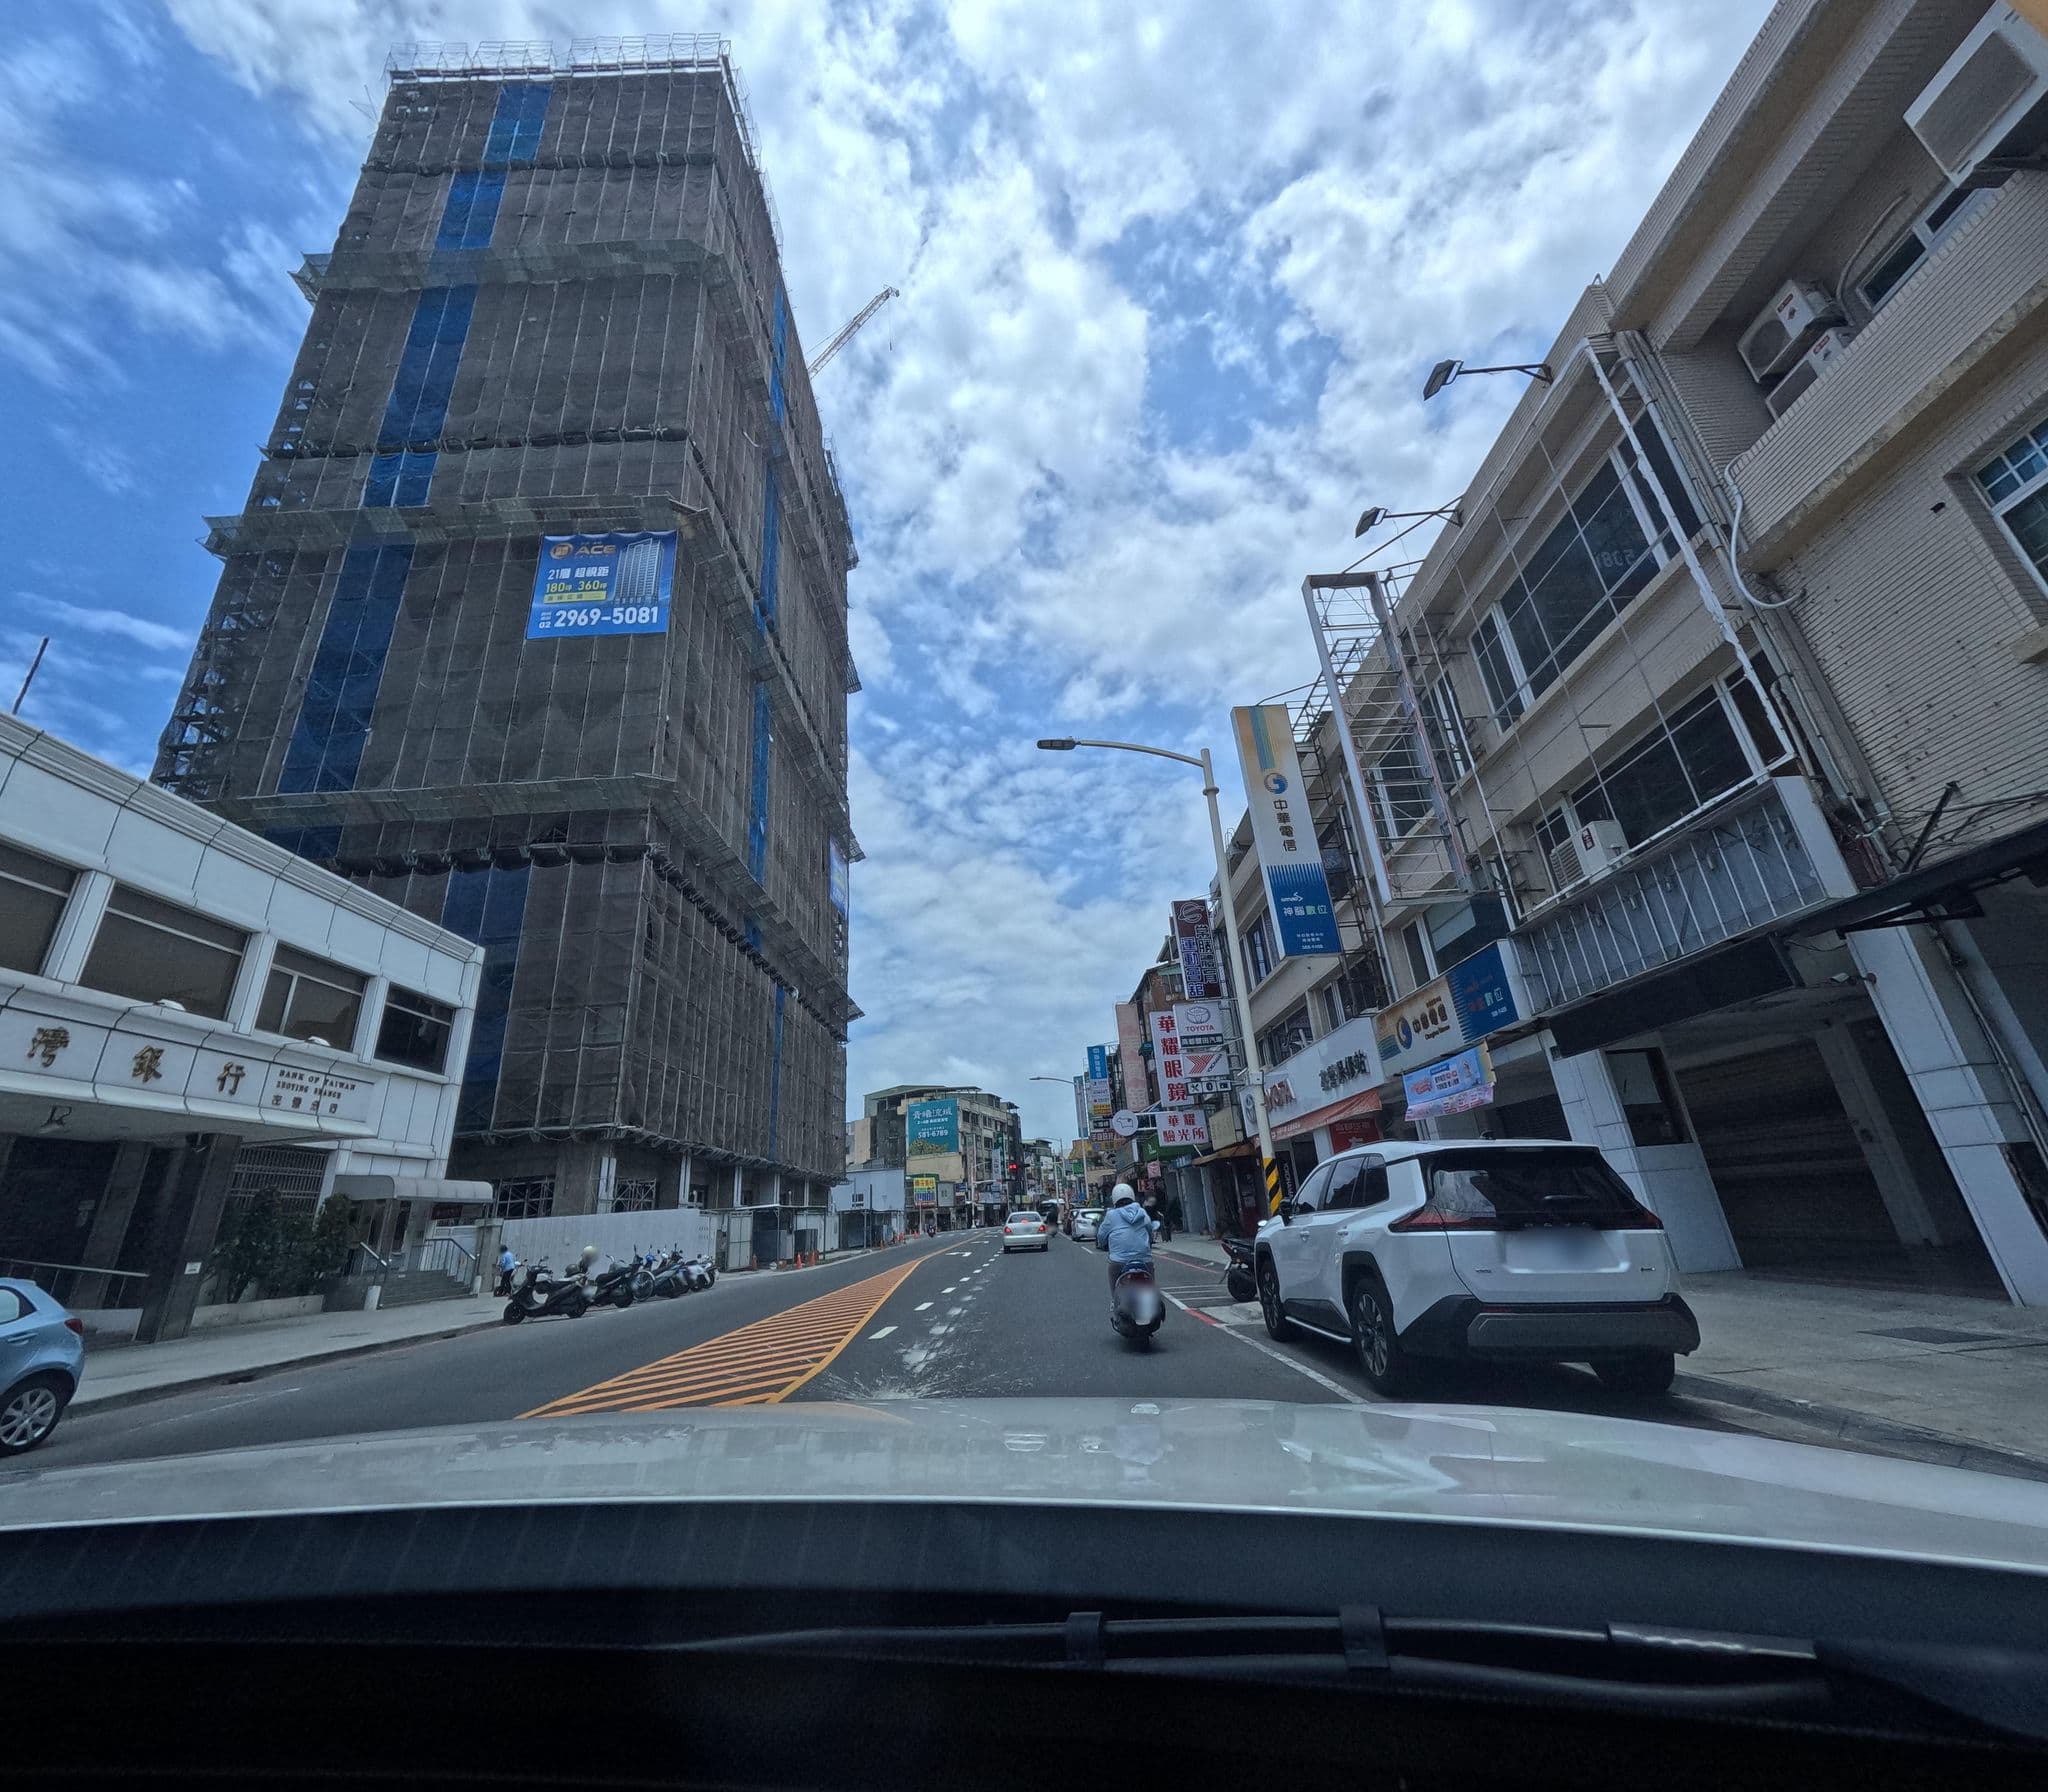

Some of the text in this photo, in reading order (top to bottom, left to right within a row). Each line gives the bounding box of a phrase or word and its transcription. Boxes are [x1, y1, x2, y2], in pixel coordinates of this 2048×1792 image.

[554, 606, 658, 627] 2969-5081
[1273, 799, 1297, 852] 中華電信
[1185, 1025, 1215, 1033] TOYOTA
[1157, 1015, 1188, 1101] 華耀眼鏡
[279, 1069, 304, 1081] BANK
[324, 1079, 356, 1091] TAIWAN
[1168, 1114, 1195, 1127] 華耀
[917, 1129, 949, 1139] 581-6789
[1162, 1127, 1204, 1142] 驗光所
